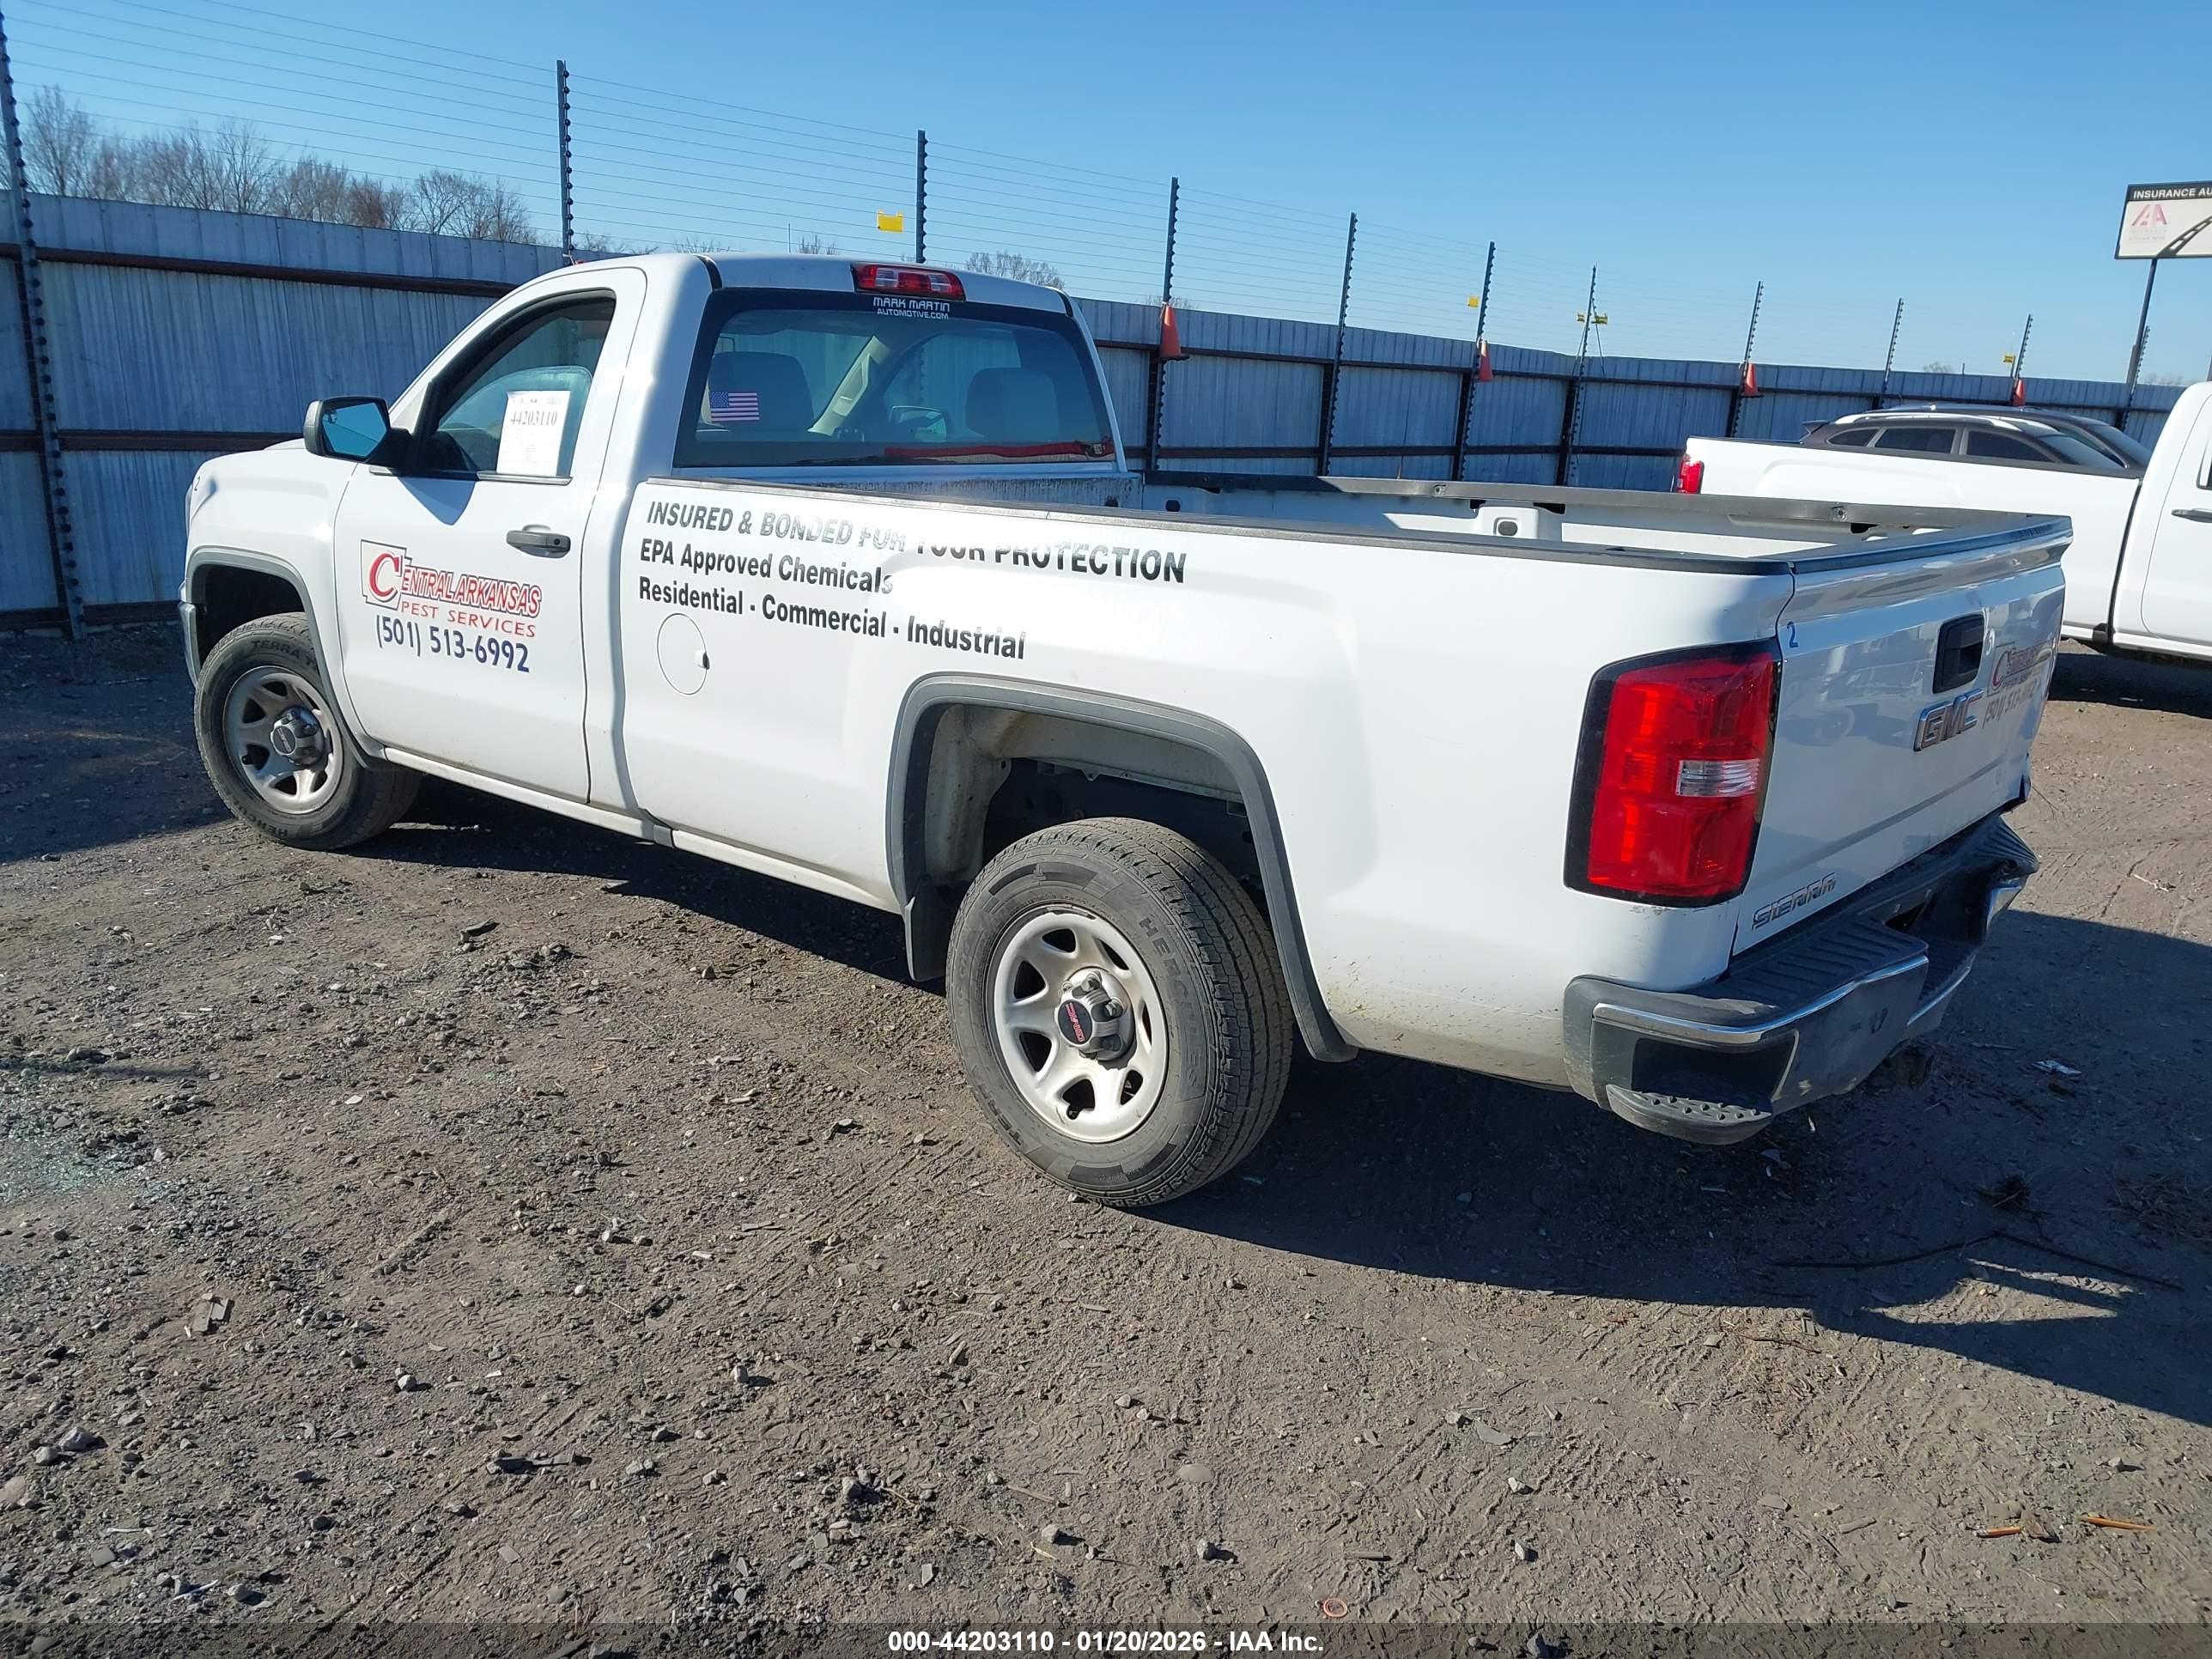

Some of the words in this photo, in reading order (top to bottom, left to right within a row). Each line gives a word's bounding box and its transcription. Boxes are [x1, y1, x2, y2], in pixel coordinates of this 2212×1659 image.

[2133, 188, 2196, 199] INSURANCE
[873, 297, 907, 309] MARK
[908, 300, 951, 312] MARTIN
[877, 308, 949, 320] AUTOMOTIVE.COM
[510, 410, 558, 426] 44203110
[647, 501, 733, 532] INSURED
[738, 510, 752, 534] &
[760, 512, 854, 545] BONDED
[994, 540, 1187, 584] PROTECTION
[641, 538, 675, 566] EPA
[680, 543, 773, 579] Approved
[778, 555, 894, 594] Chemicals
[454, 574, 543, 618] ARKANSAS
[639, 575, 744, 615] Residential
[762, 593, 887, 638] Commercial
[907, 615, 1027, 660] Industrial
[400, 601, 440, 619] PEST
[447, 610, 537, 638] SERVICES
[1787, 620, 1800, 649] 2
[376, 614, 422, 657] (501)
[429, 625, 530, 673] 513-6992
[1912, 687, 1985, 752] GMC
[1751, 872, 1838, 931] SIERRA
